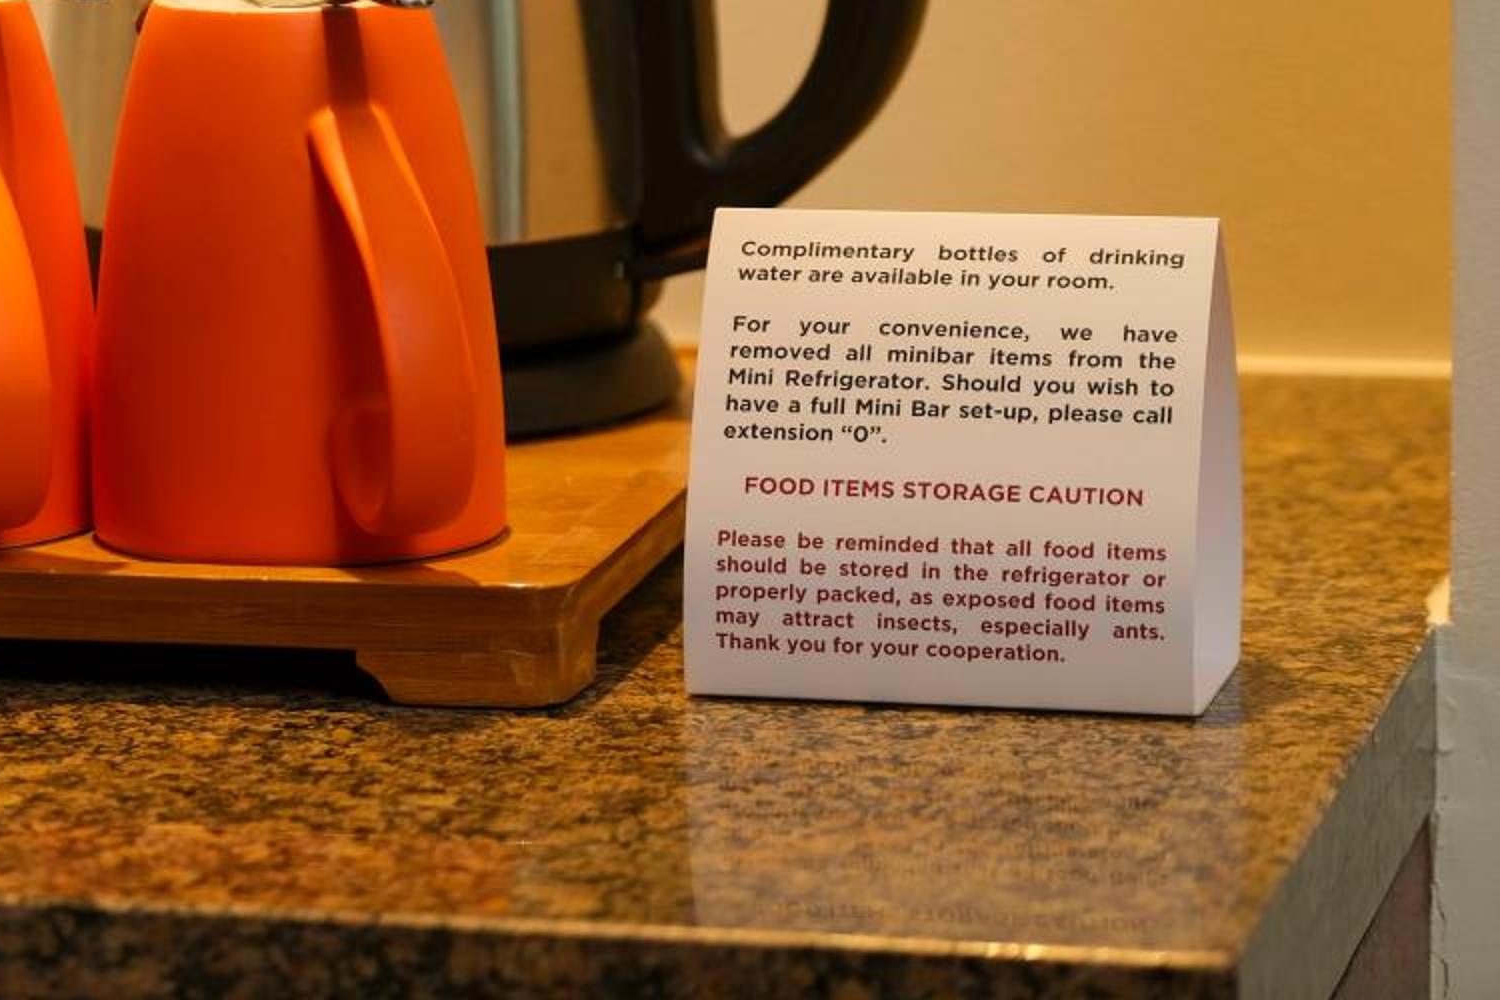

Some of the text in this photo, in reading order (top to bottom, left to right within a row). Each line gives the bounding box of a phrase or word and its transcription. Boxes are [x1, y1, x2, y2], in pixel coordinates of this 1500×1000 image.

[740, 240, 1186, 270] Complimentary bottles of drinking
[737, 265, 1115, 291] water are available in your room.
[732, 314, 1179, 344] For your convenience, we have
[729, 342, 1177, 371] removed all minibar items from the
[727, 367, 1175, 398] Mini Refrigerator. Should you wish to
[724, 393, 1173, 425] have a full Mini Bar set-up, please call
[723, 422, 834, 443] extension
[744, 475, 1144, 508] FOOD ITEMS STORAGE CAUTION
[716, 528, 1168, 563] Please be reminded that all food items
[715, 554, 1167, 589] should be stored in the refrigerator or
[715, 583, 1166, 616] properly packed, as exposed food items
[715, 609, 1165, 642] may attract insects, especially ants.
[714, 631, 1066, 664] Thank you for your cooperation.
